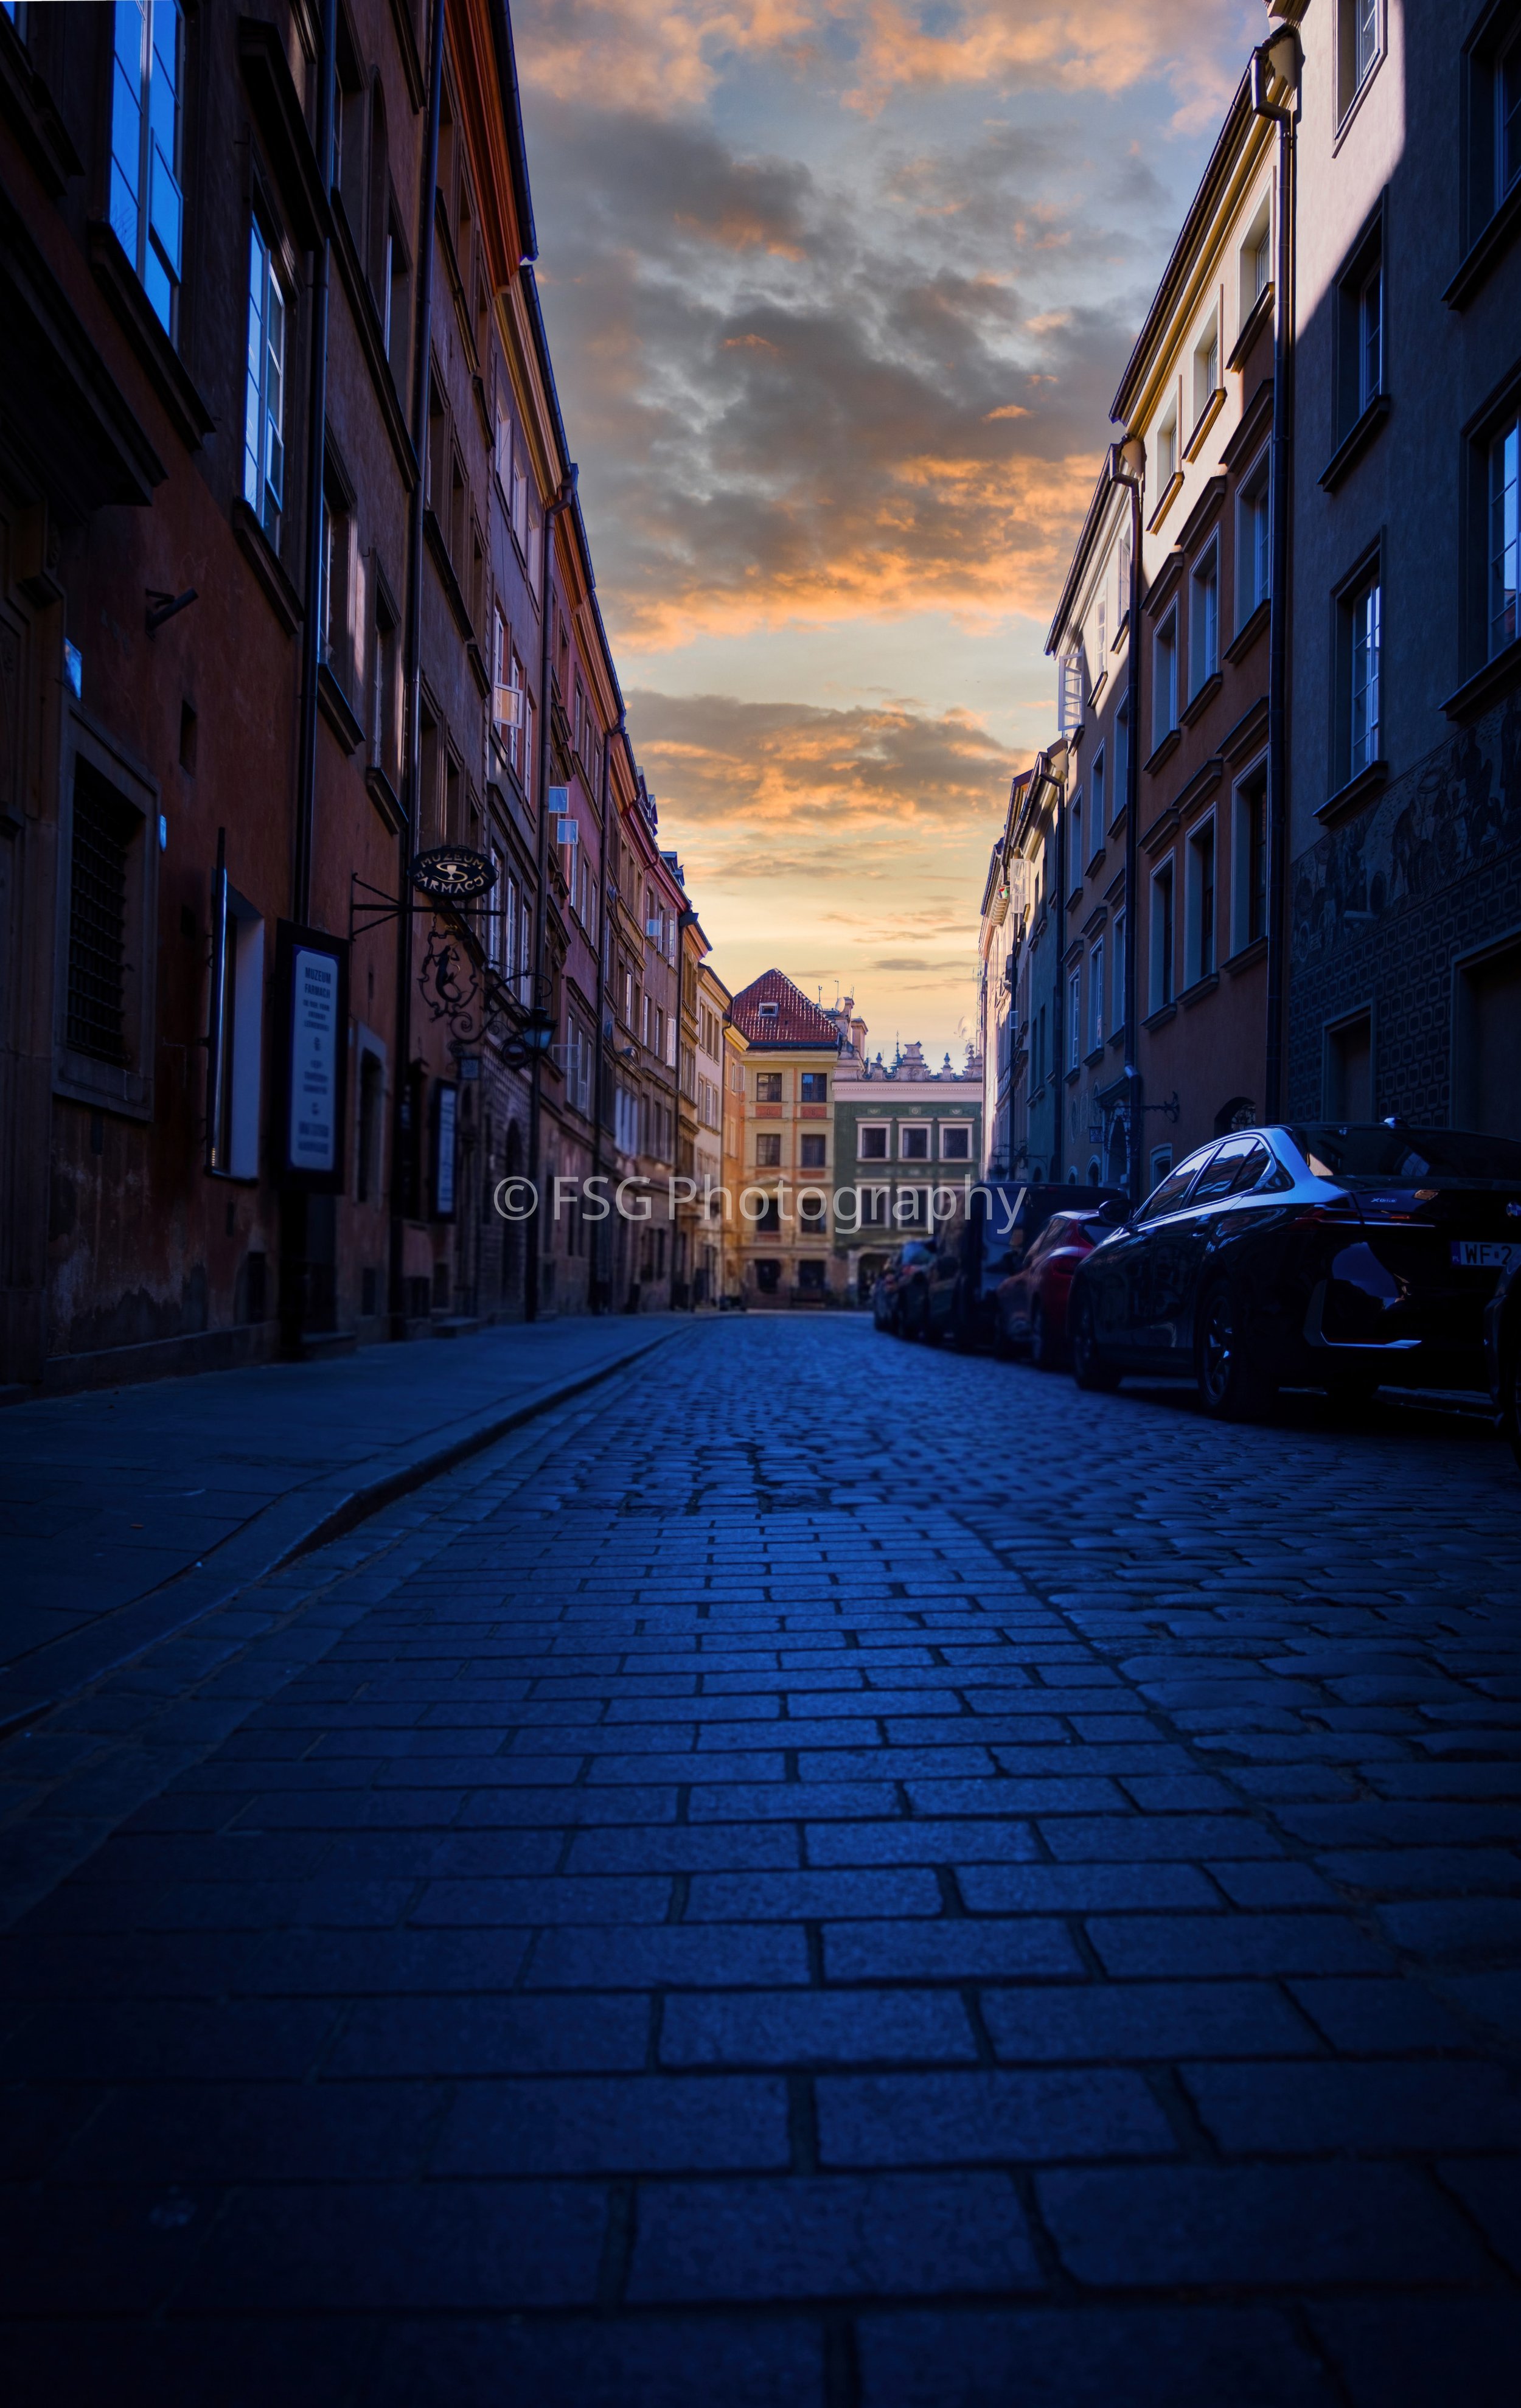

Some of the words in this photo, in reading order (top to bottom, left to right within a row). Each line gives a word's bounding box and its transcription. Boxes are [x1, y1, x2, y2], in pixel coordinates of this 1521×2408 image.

[420, 852, 485, 870] MUZEUM
[414, 871, 489, 894] FARMACJI
[305, 967, 331, 984] MUZEUM
[304, 983, 330, 999] FARMACJI
